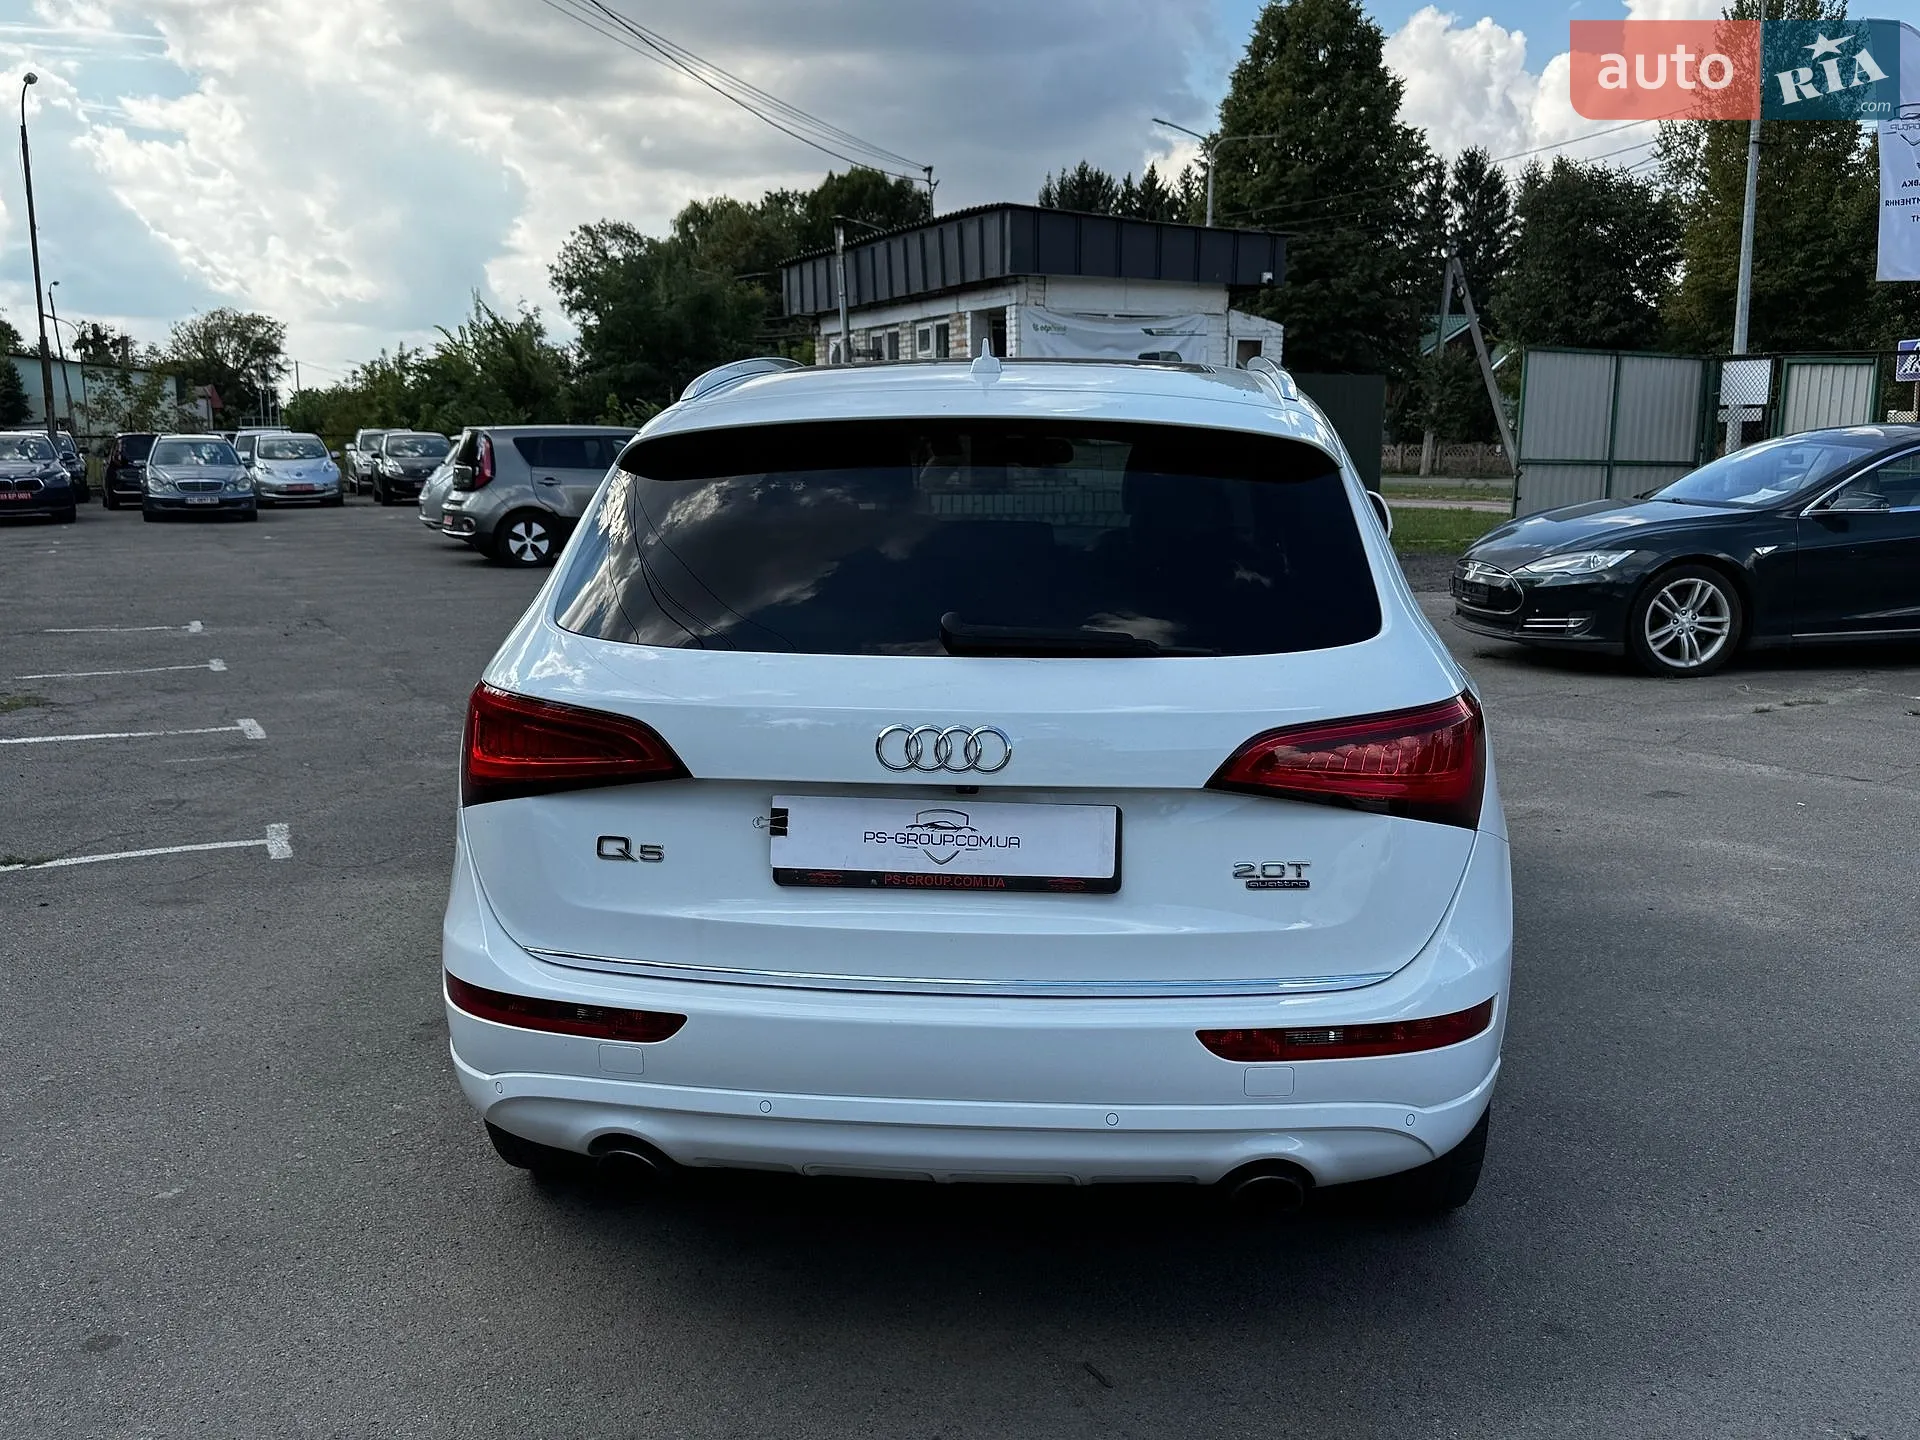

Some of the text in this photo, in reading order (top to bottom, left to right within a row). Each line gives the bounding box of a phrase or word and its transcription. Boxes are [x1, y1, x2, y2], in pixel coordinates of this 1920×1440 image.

[863, 831, 1021, 848] PS-GROUP.COM.UA
[596, 835, 665, 862] Q5
[1232, 861, 1311, 879] 2.0T
[884, 874, 1006, 888] PS-GROUP.COM.UA
[1248, 880, 1309, 888] quattro
